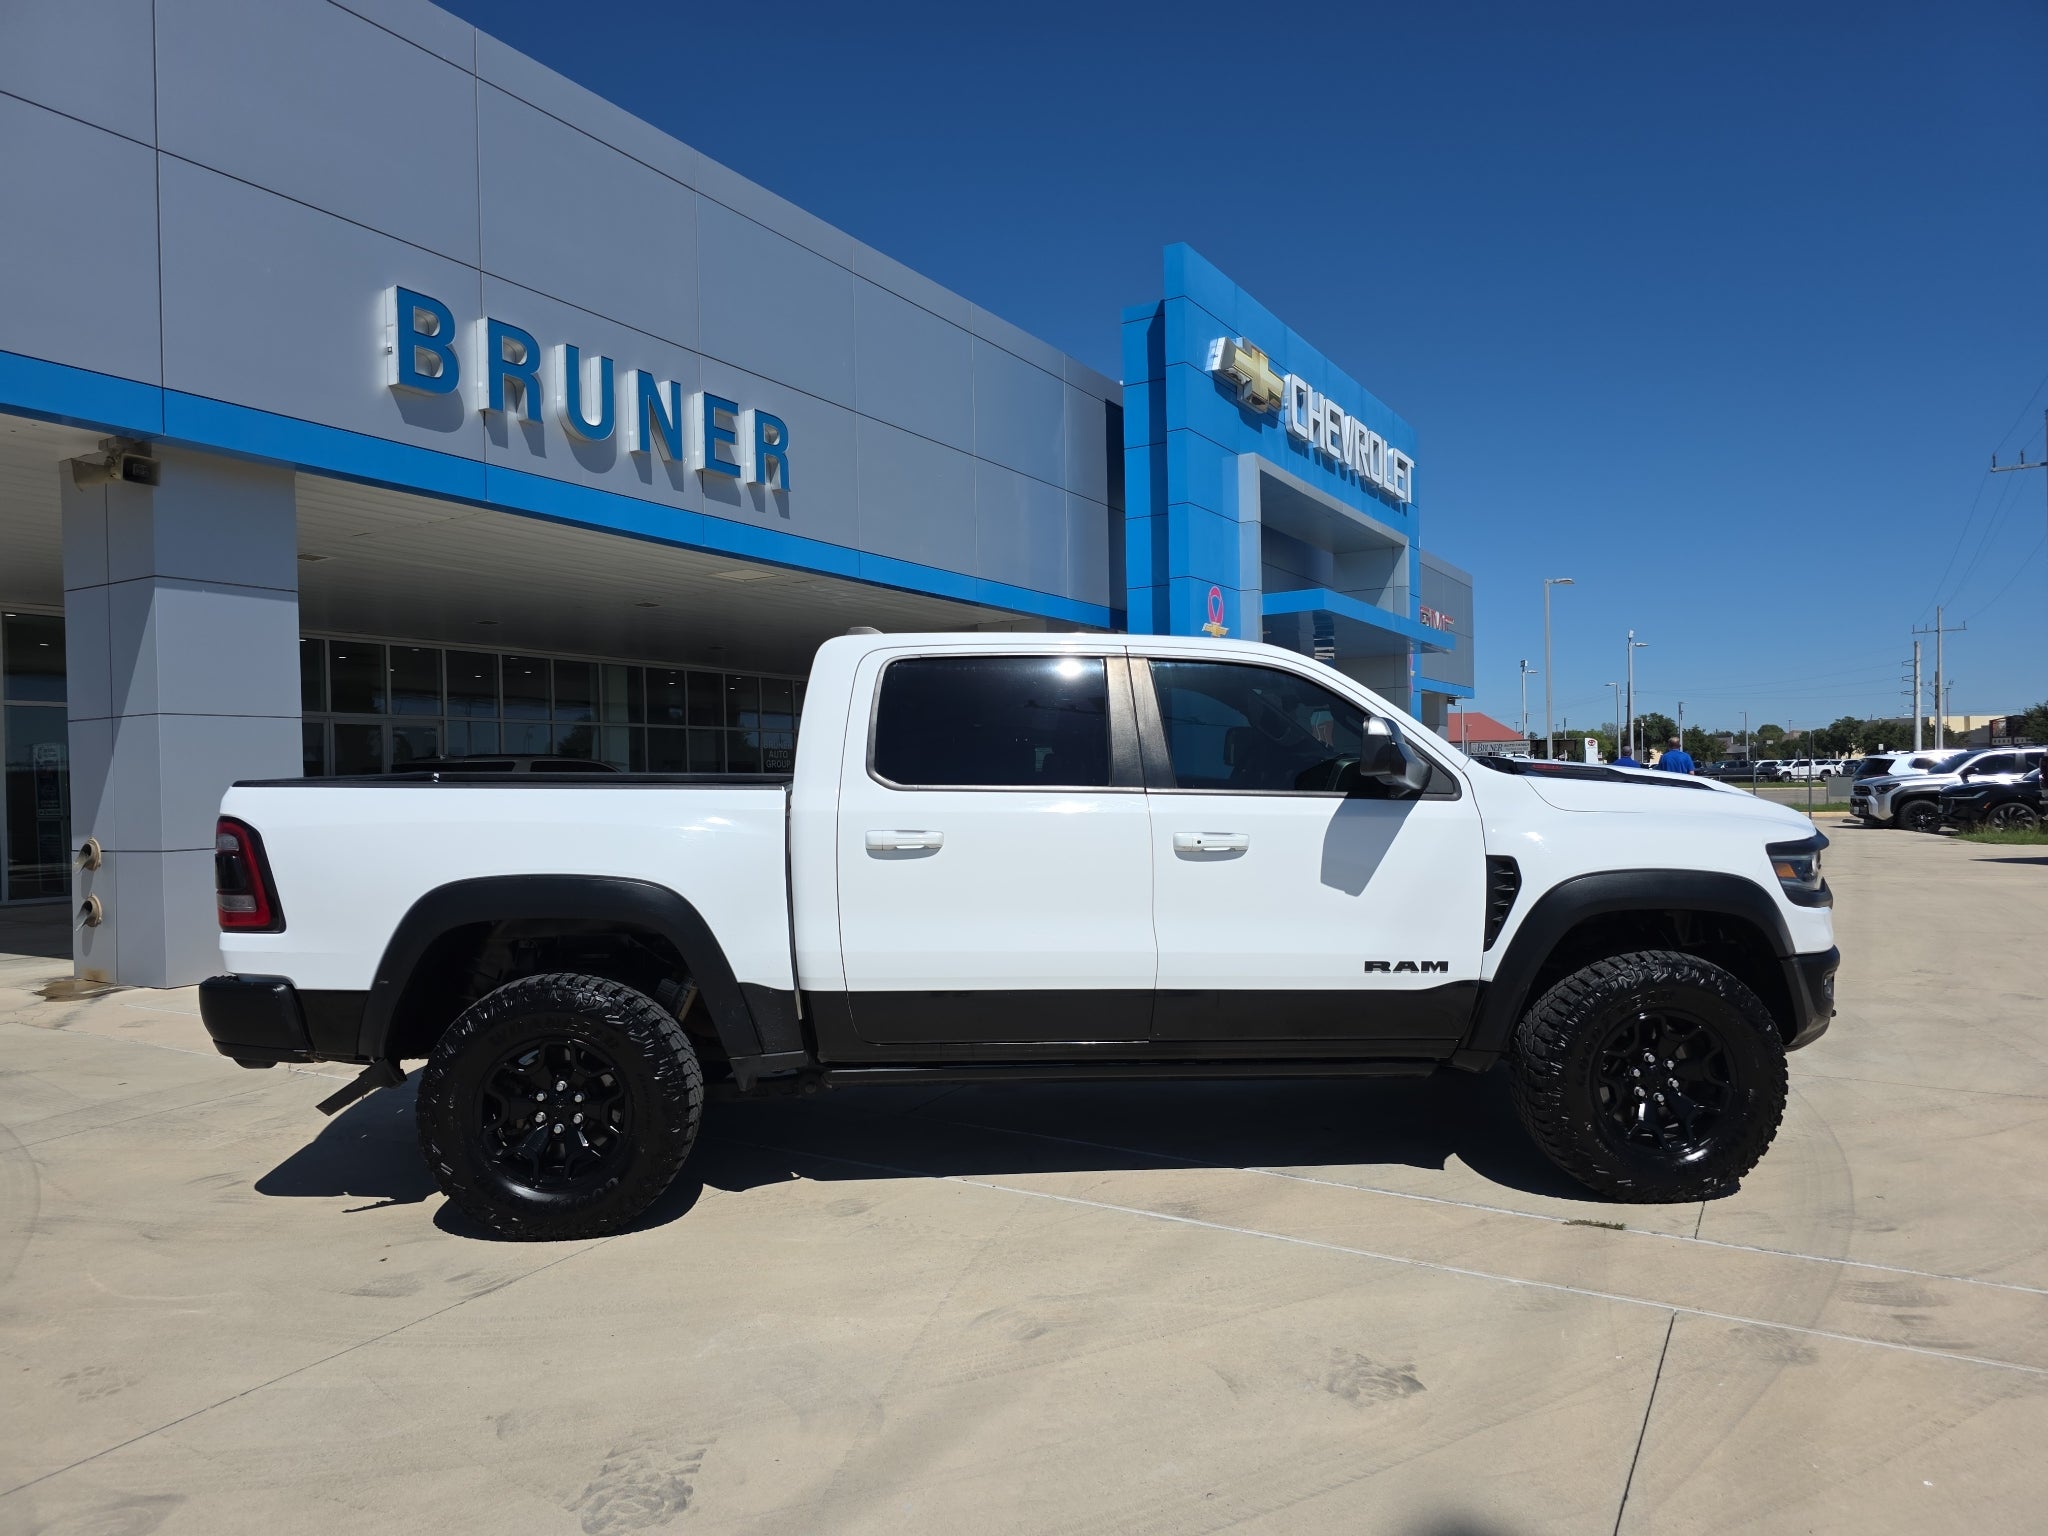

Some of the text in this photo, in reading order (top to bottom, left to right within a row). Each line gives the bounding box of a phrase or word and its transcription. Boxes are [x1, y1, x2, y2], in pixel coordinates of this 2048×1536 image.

[386, 285, 791, 492] BRUNER
[1284, 374, 1415, 503] CHEVROLET
[1420, 606, 1454, 632] GMC
[1477, 743, 1503, 752] BRUNER
[768, 750, 788, 759] AUTO
[766, 759, 791, 768] GROUP
[1364, 960, 1449, 973] RAM
